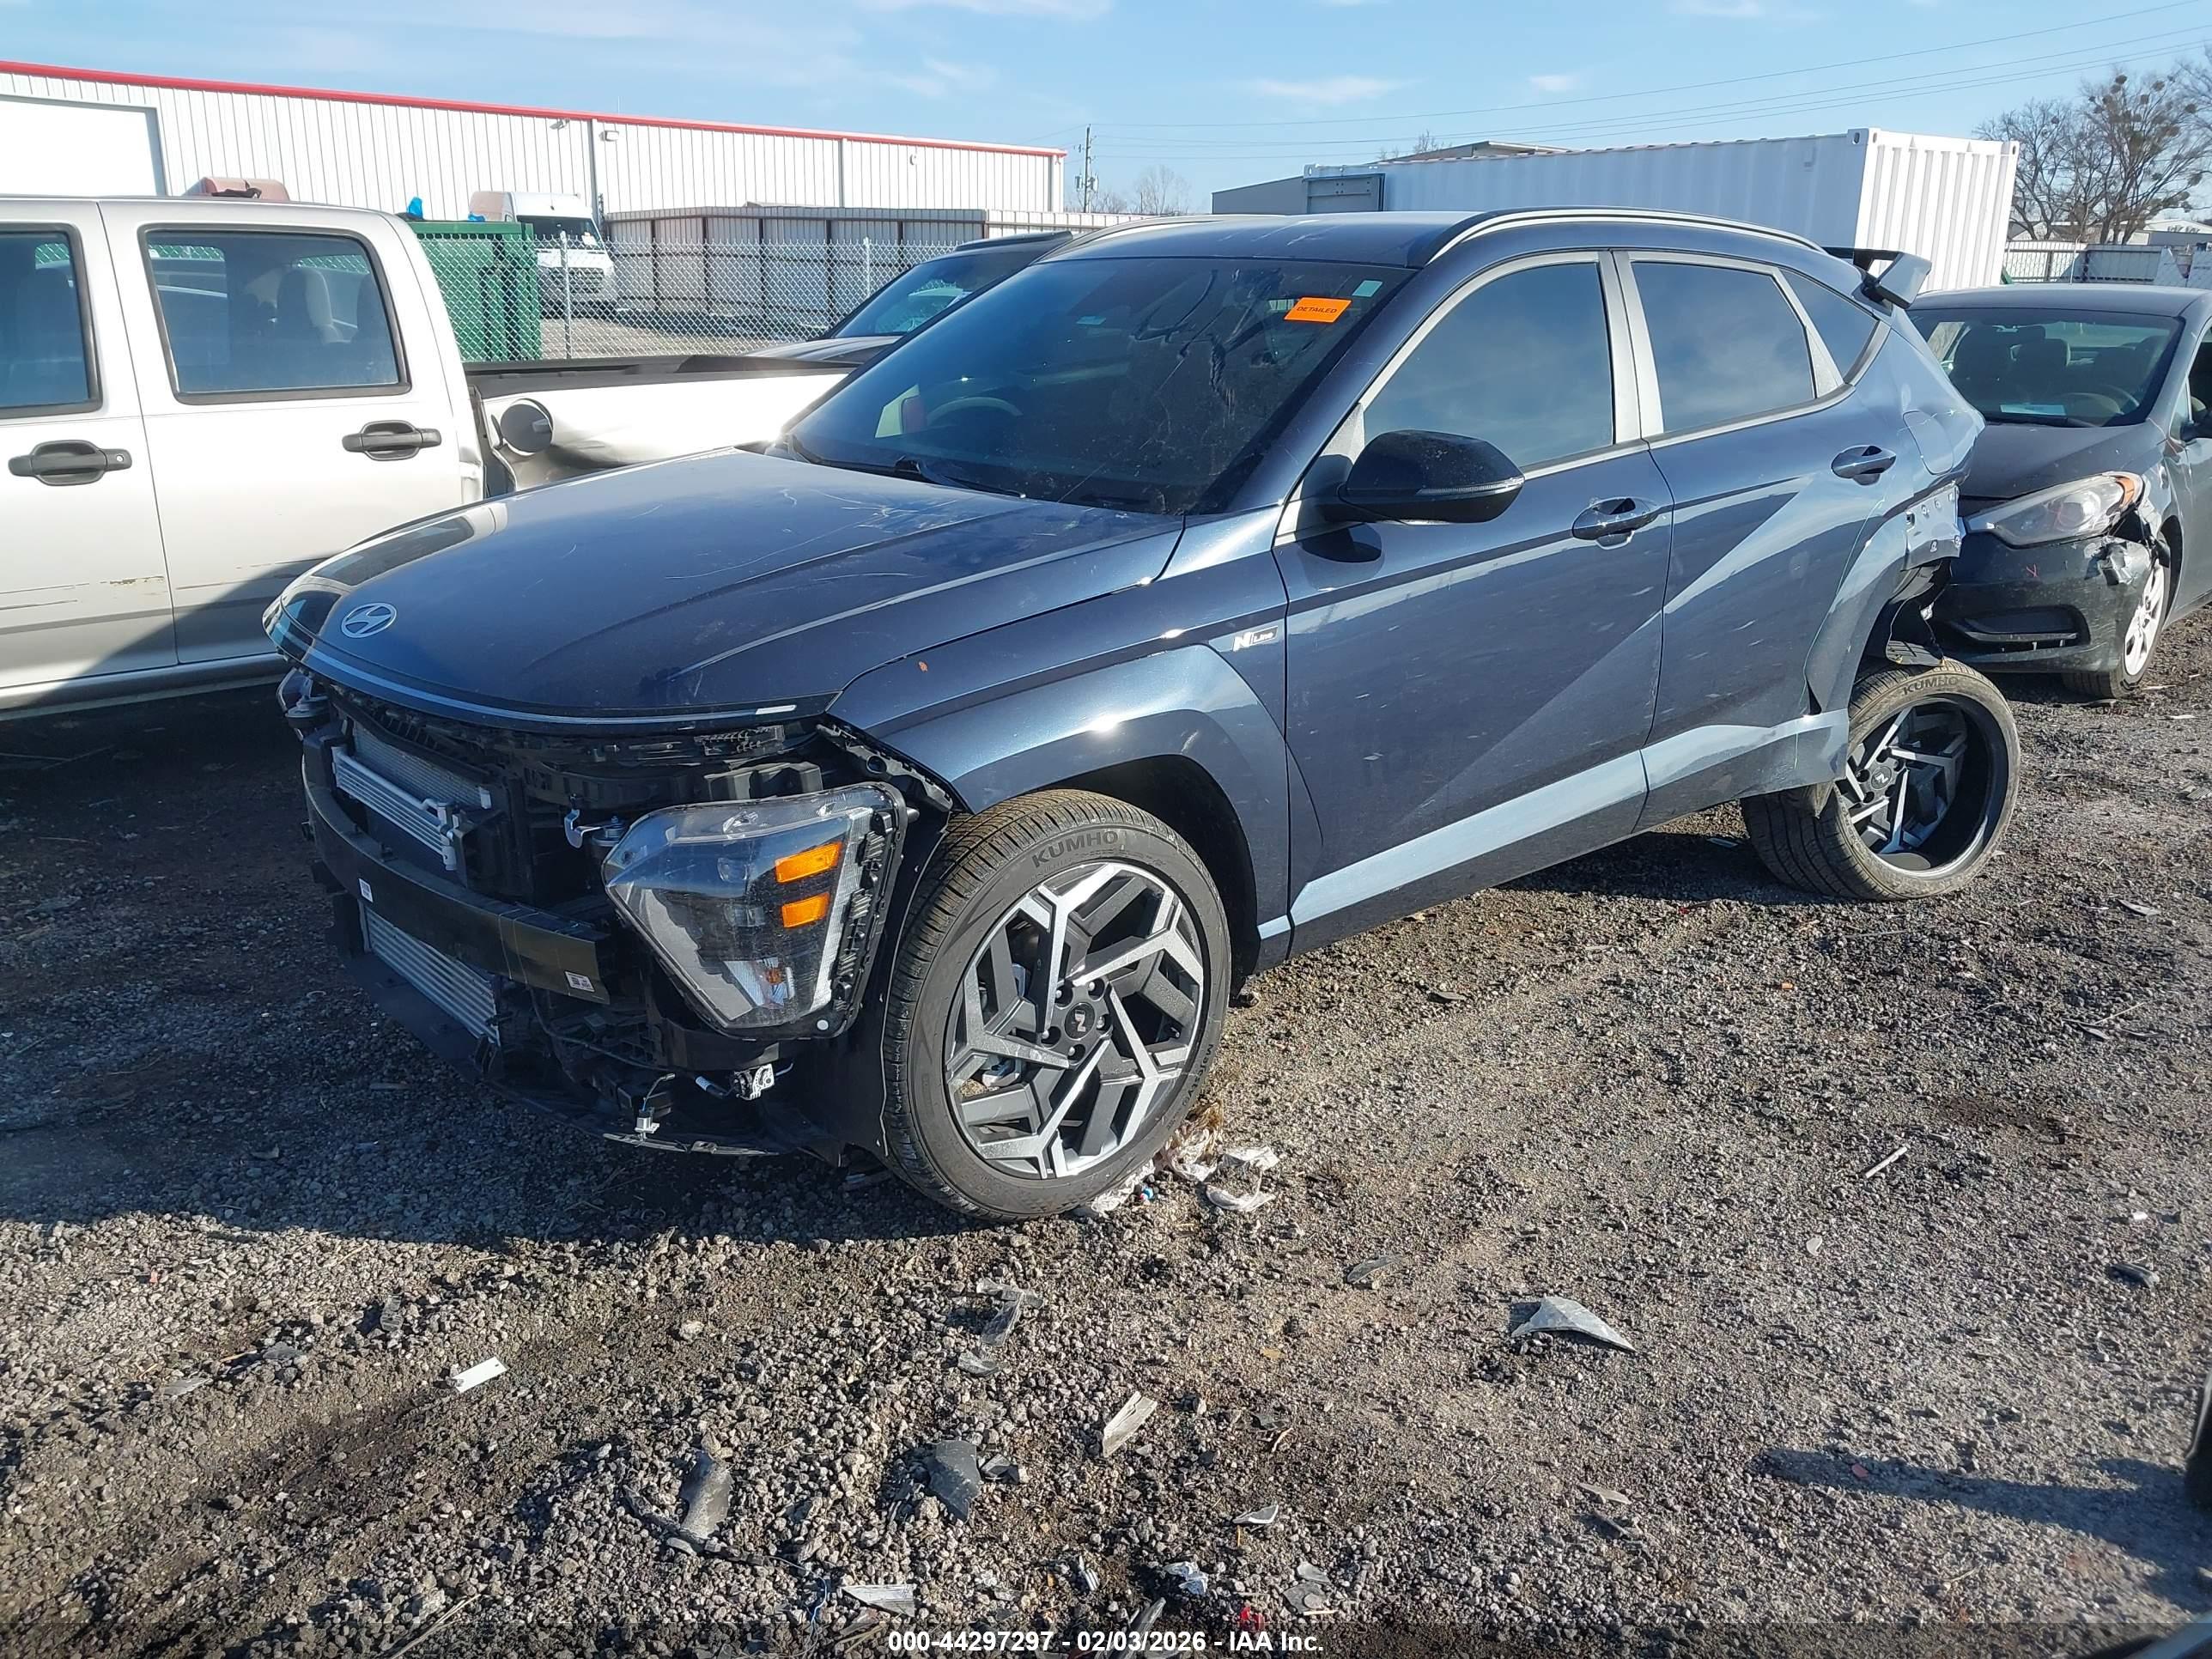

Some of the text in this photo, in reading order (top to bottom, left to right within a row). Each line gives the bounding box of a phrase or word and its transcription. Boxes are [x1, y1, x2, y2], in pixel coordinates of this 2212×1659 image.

[1297, 306, 1337, 314] DETAILED
[1903, 676, 1959, 695] KUMHO
[1032, 830, 1119, 868] KUMHO
